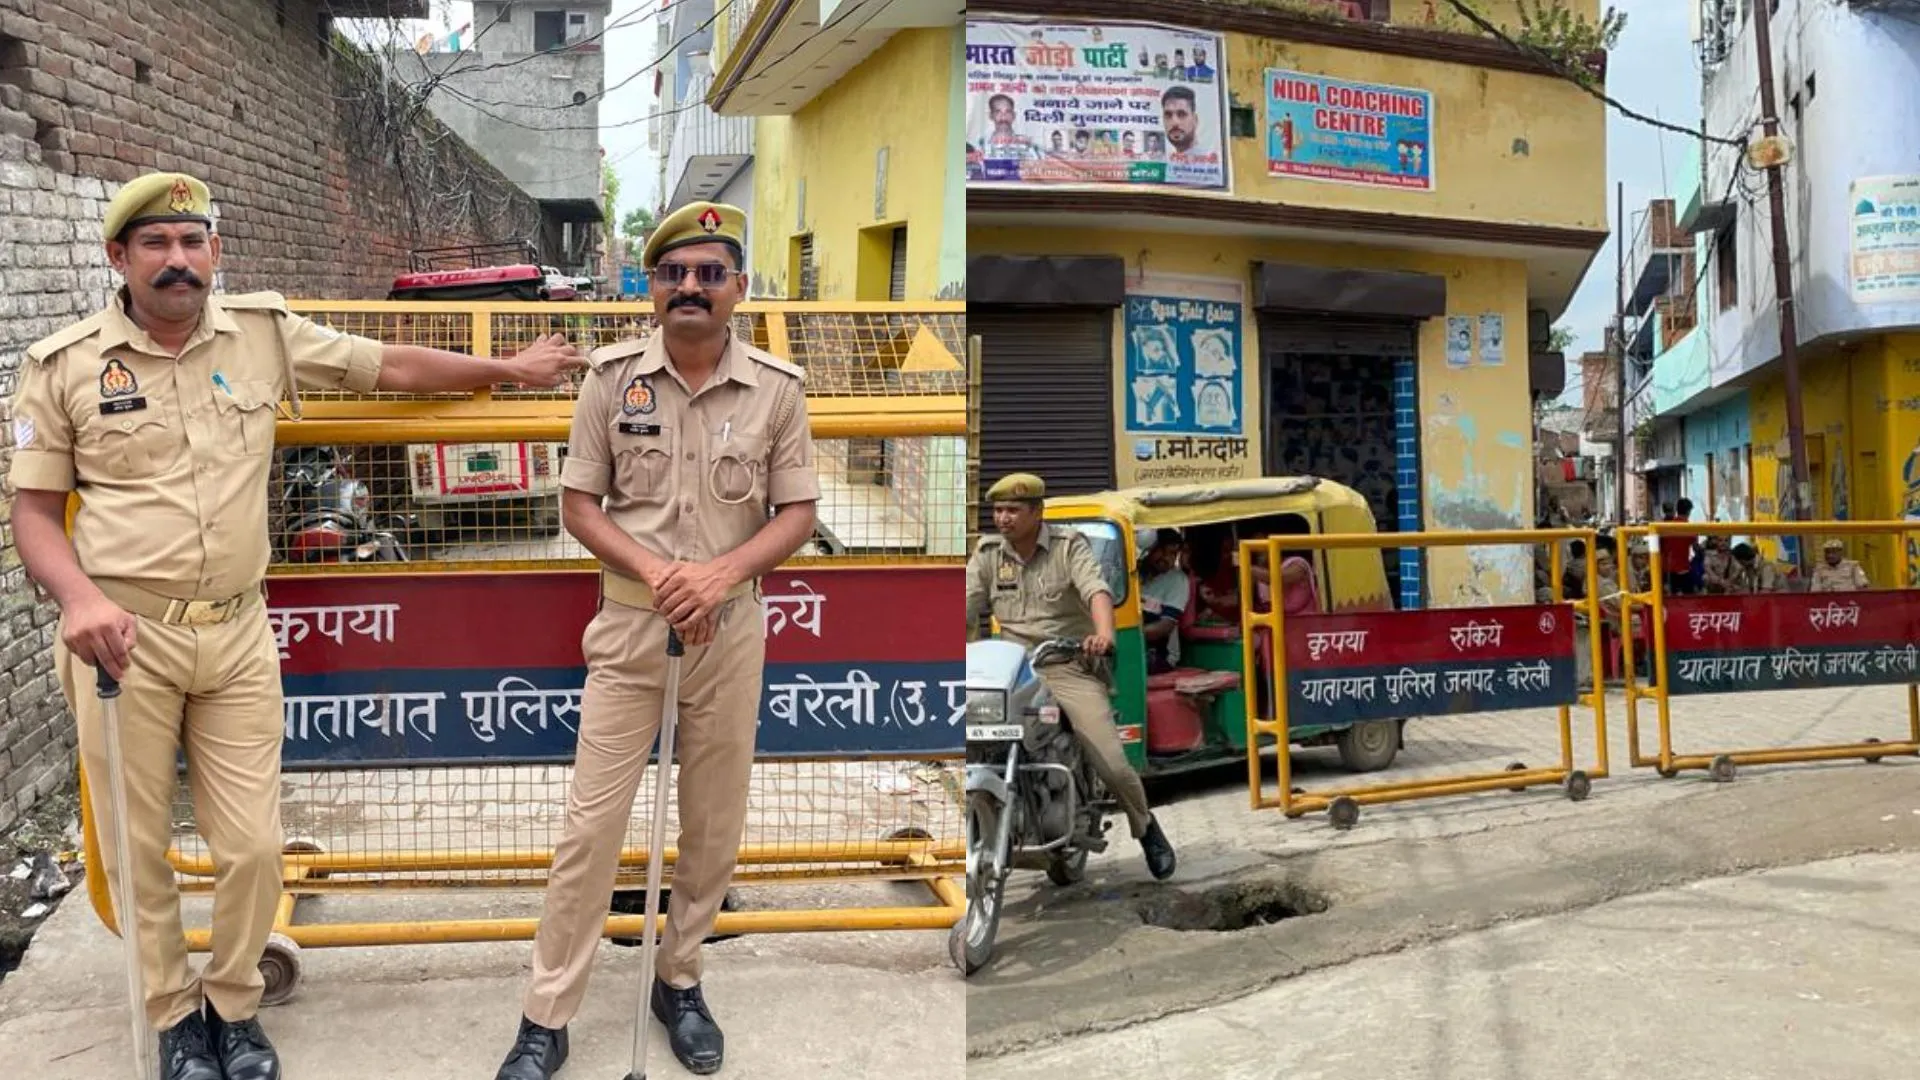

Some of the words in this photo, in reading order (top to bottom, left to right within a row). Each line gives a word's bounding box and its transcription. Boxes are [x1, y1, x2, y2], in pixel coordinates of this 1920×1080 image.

[1082, 42, 1129, 68] पार्टी
[1273, 78, 1320, 103] NIDA
[1326, 86, 1424, 117] COACHING
[1315, 109, 1386, 137] CENTRE
[268, 604, 400, 659] कृपया
[1307, 631, 1368, 660] कृपया
[1450, 619, 1503, 651] रुकिये
[1689, 612, 1742, 639] कृपया
[1809, 602, 1861, 631] रुकिये
[1301, 676, 1376, 706] यातायात
[1384, 667, 1436, 703] पुलिस
[1443, 669, 1496, 695] जनपद
[1507, 659, 1552, 691] बरेली
[1678, 655, 1765, 685] यातायात
[1770, 647, 1820, 681] पुलिस
[1823, 651, 1869, 677] जनपद
[1875, 643, 1919, 676] बरेली
